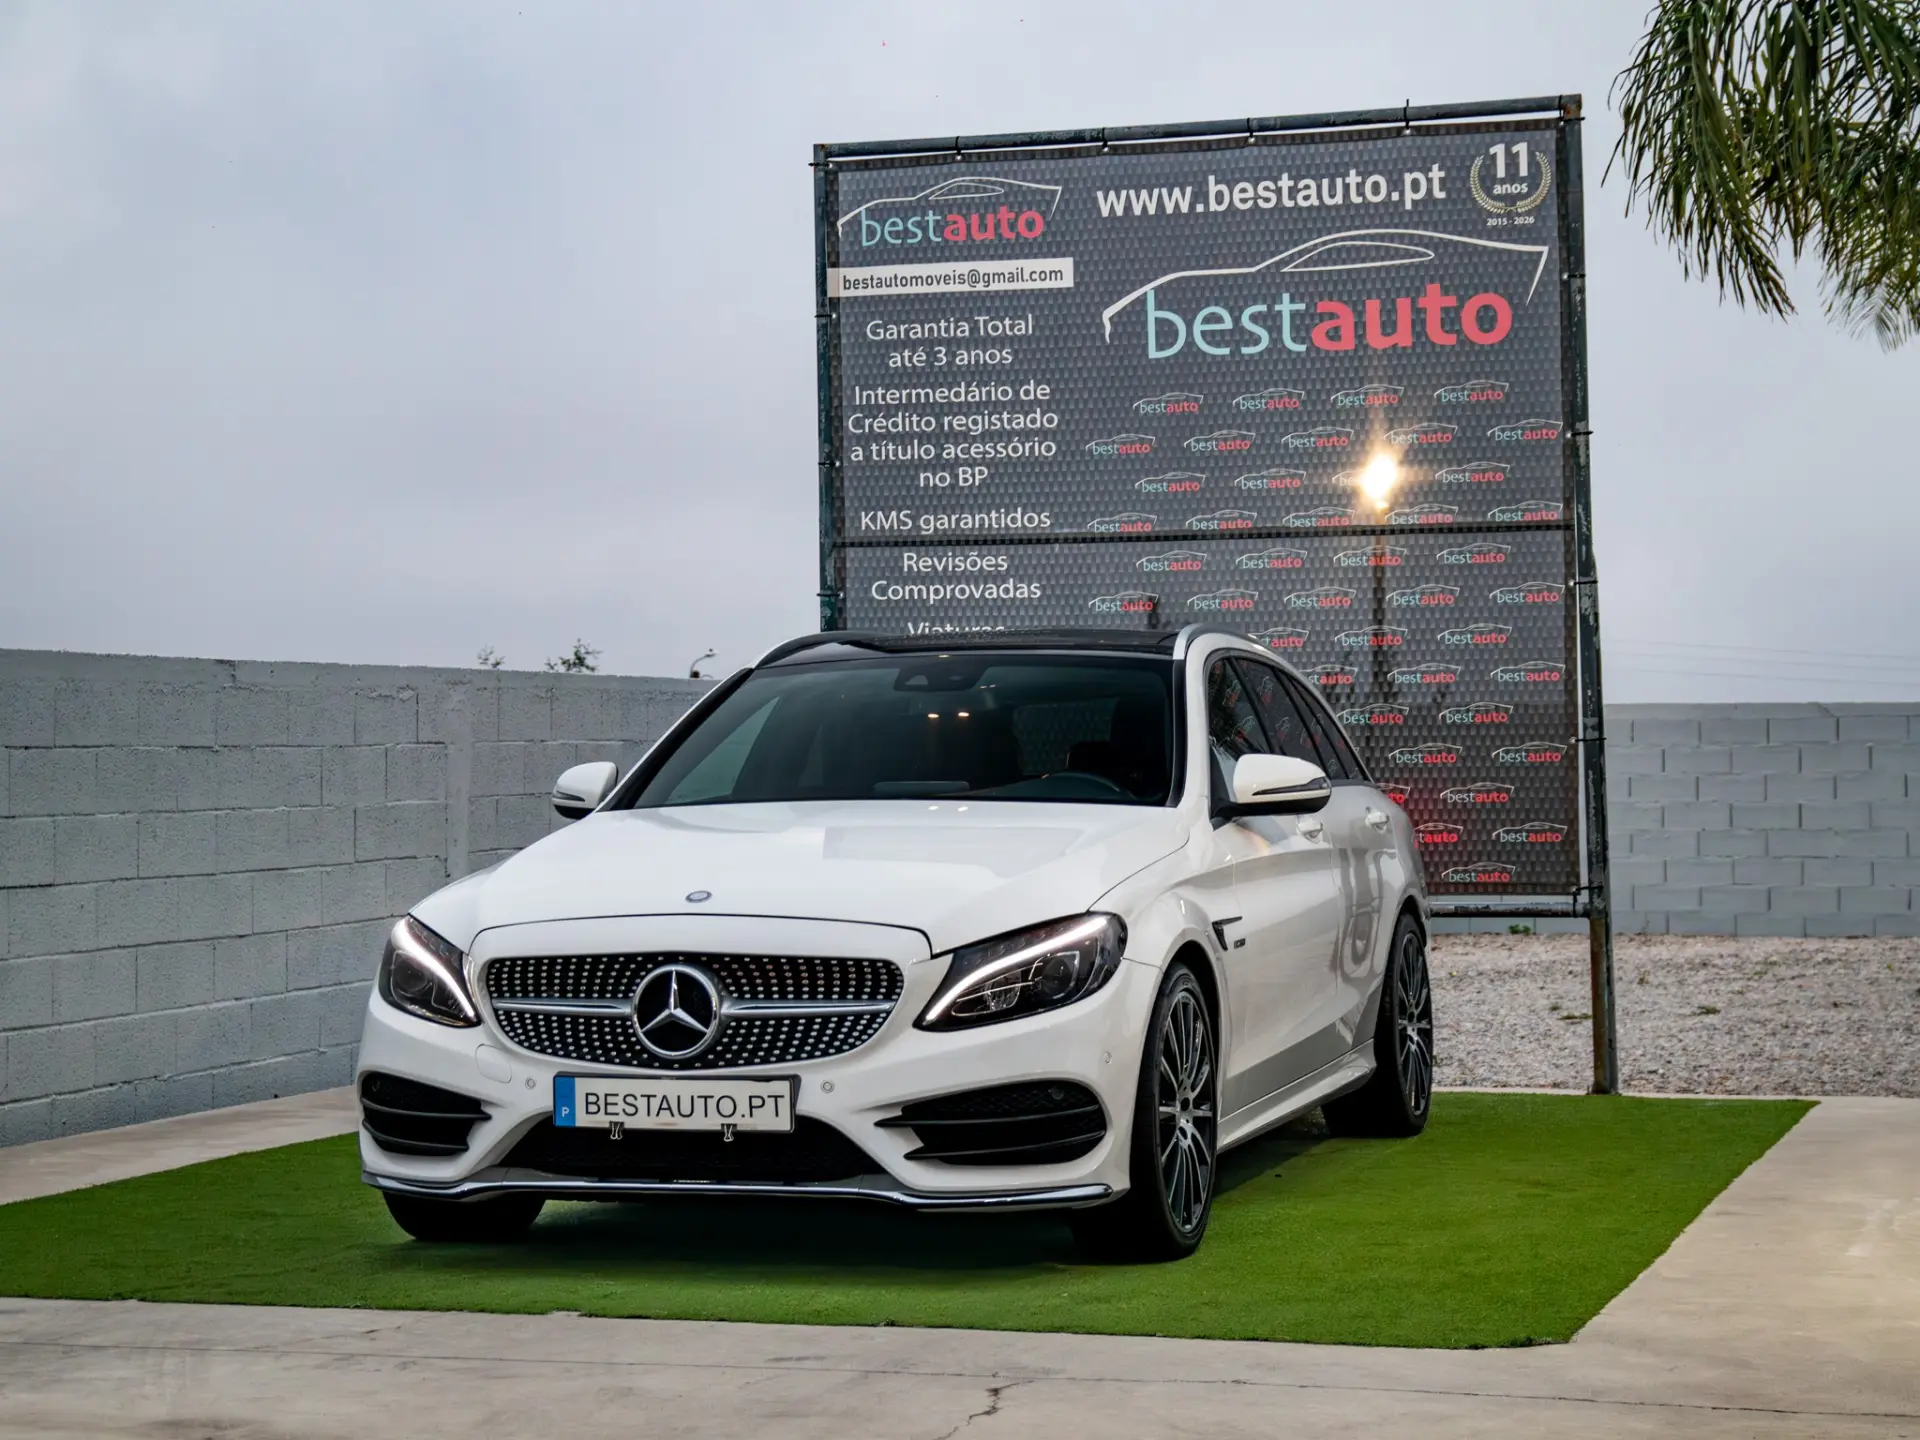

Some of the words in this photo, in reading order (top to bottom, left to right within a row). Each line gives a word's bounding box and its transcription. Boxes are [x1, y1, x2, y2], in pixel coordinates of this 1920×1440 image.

[1489, 142, 1529, 178] 11
[1096, 163, 1447, 218] www.bestauto.pt
[1493, 183, 1529, 195] anos
[860, 205, 1045, 247] bestauto
[1486, 217, 1508, 226] 2015
[1513, 215, 1535, 225] 2026
[842, 267, 1064, 291] bestautomoveis@gmail.com
[866, 317, 970, 341] Garantia
[974, 314, 1033, 337] Total
[1145, 283, 1513, 359] bestauto
[888, 346, 927, 368] até
[933, 347, 948, 367] 3
[956, 347, 1013, 366] anos
[854, 381, 1013, 405] Intermedário
[1020, 379, 1051, 400] de
[1441, 390, 1503, 402] bestauto
[1240, 397, 1300, 410] bestauto
[1338, 393, 1398, 406] bestauto
[1140, 401, 1199, 413] bestauto
[848, 411, 936, 433] Crédito
[943, 408, 1059, 435] registado
[1390, 431, 1452, 444] bestauto
[1495, 428, 1558, 441] bestauto
[1092, 441, 1150, 455] bestauto
[1191, 438, 1250, 451] bestauto
[1288, 435, 1348, 448] bestauto
[850, 446, 864, 461] a
[870, 439, 935, 460] título
[942, 437, 1057, 459] acessório
[919, 471, 950, 487] no
[958, 466, 989, 487] BP
[1442, 471, 1504, 483] bestauto
[1142, 480, 1200, 493] bestauto
[1241, 477, 1301, 490] bestauto
[861, 510, 913, 531] KMS
[919, 507, 1051, 534] garantidos
[1290, 515, 1349, 527] bestauto
[1392, 512, 1453, 525] bestauto
[1495, 509, 1557, 521] bestauto
[1094, 520, 1152, 533] bestauto
[1192, 517, 1251, 530] bestauto
[903, 551, 1008, 572] Revisões
[1242, 556, 1302, 569] bestauto
[1340, 554, 1400, 567] bestauto
[1444, 551, 1505, 564] bestauto
[1143, 559, 1201, 572] bestauto
[871, 578, 1042, 604] Comprovadas
[1497, 590, 1559, 603] bestauto
[1095, 599, 1153, 612] bestauto
[1194, 597, 1254, 610] bestauto
[1291, 595, 1351, 608] bestauto
[1393, 593, 1454, 606] bestauto
[1262, 635, 1304, 648] tauto
[1341, 633, 1403, 646] bestauto
[1445, 631, 1507, 644] bestauto
[1308, 672, 1352, 685] stauto
[1395, 670, 1456, 684] bestauto
[1497, 668, 1560, 682] bestauto
[1343, 711, 1404, 725] bestauto
[1446, 709, 1508, 723] bestauto
[1396, 751, 1457, 764] bestauto
[1499, 749, 1561, 763] bestauto
[1447, 790, 1509, 803] bestauto
[1419, 832, 1458, 843] tauto
[1500, 830, 1562, 843] bestauto
[1449, 870, 1511, 883] bestauto
[561, 1106, 570, 1118] P
[585, 1092, 785, 1118] BESTAUTO.PT
